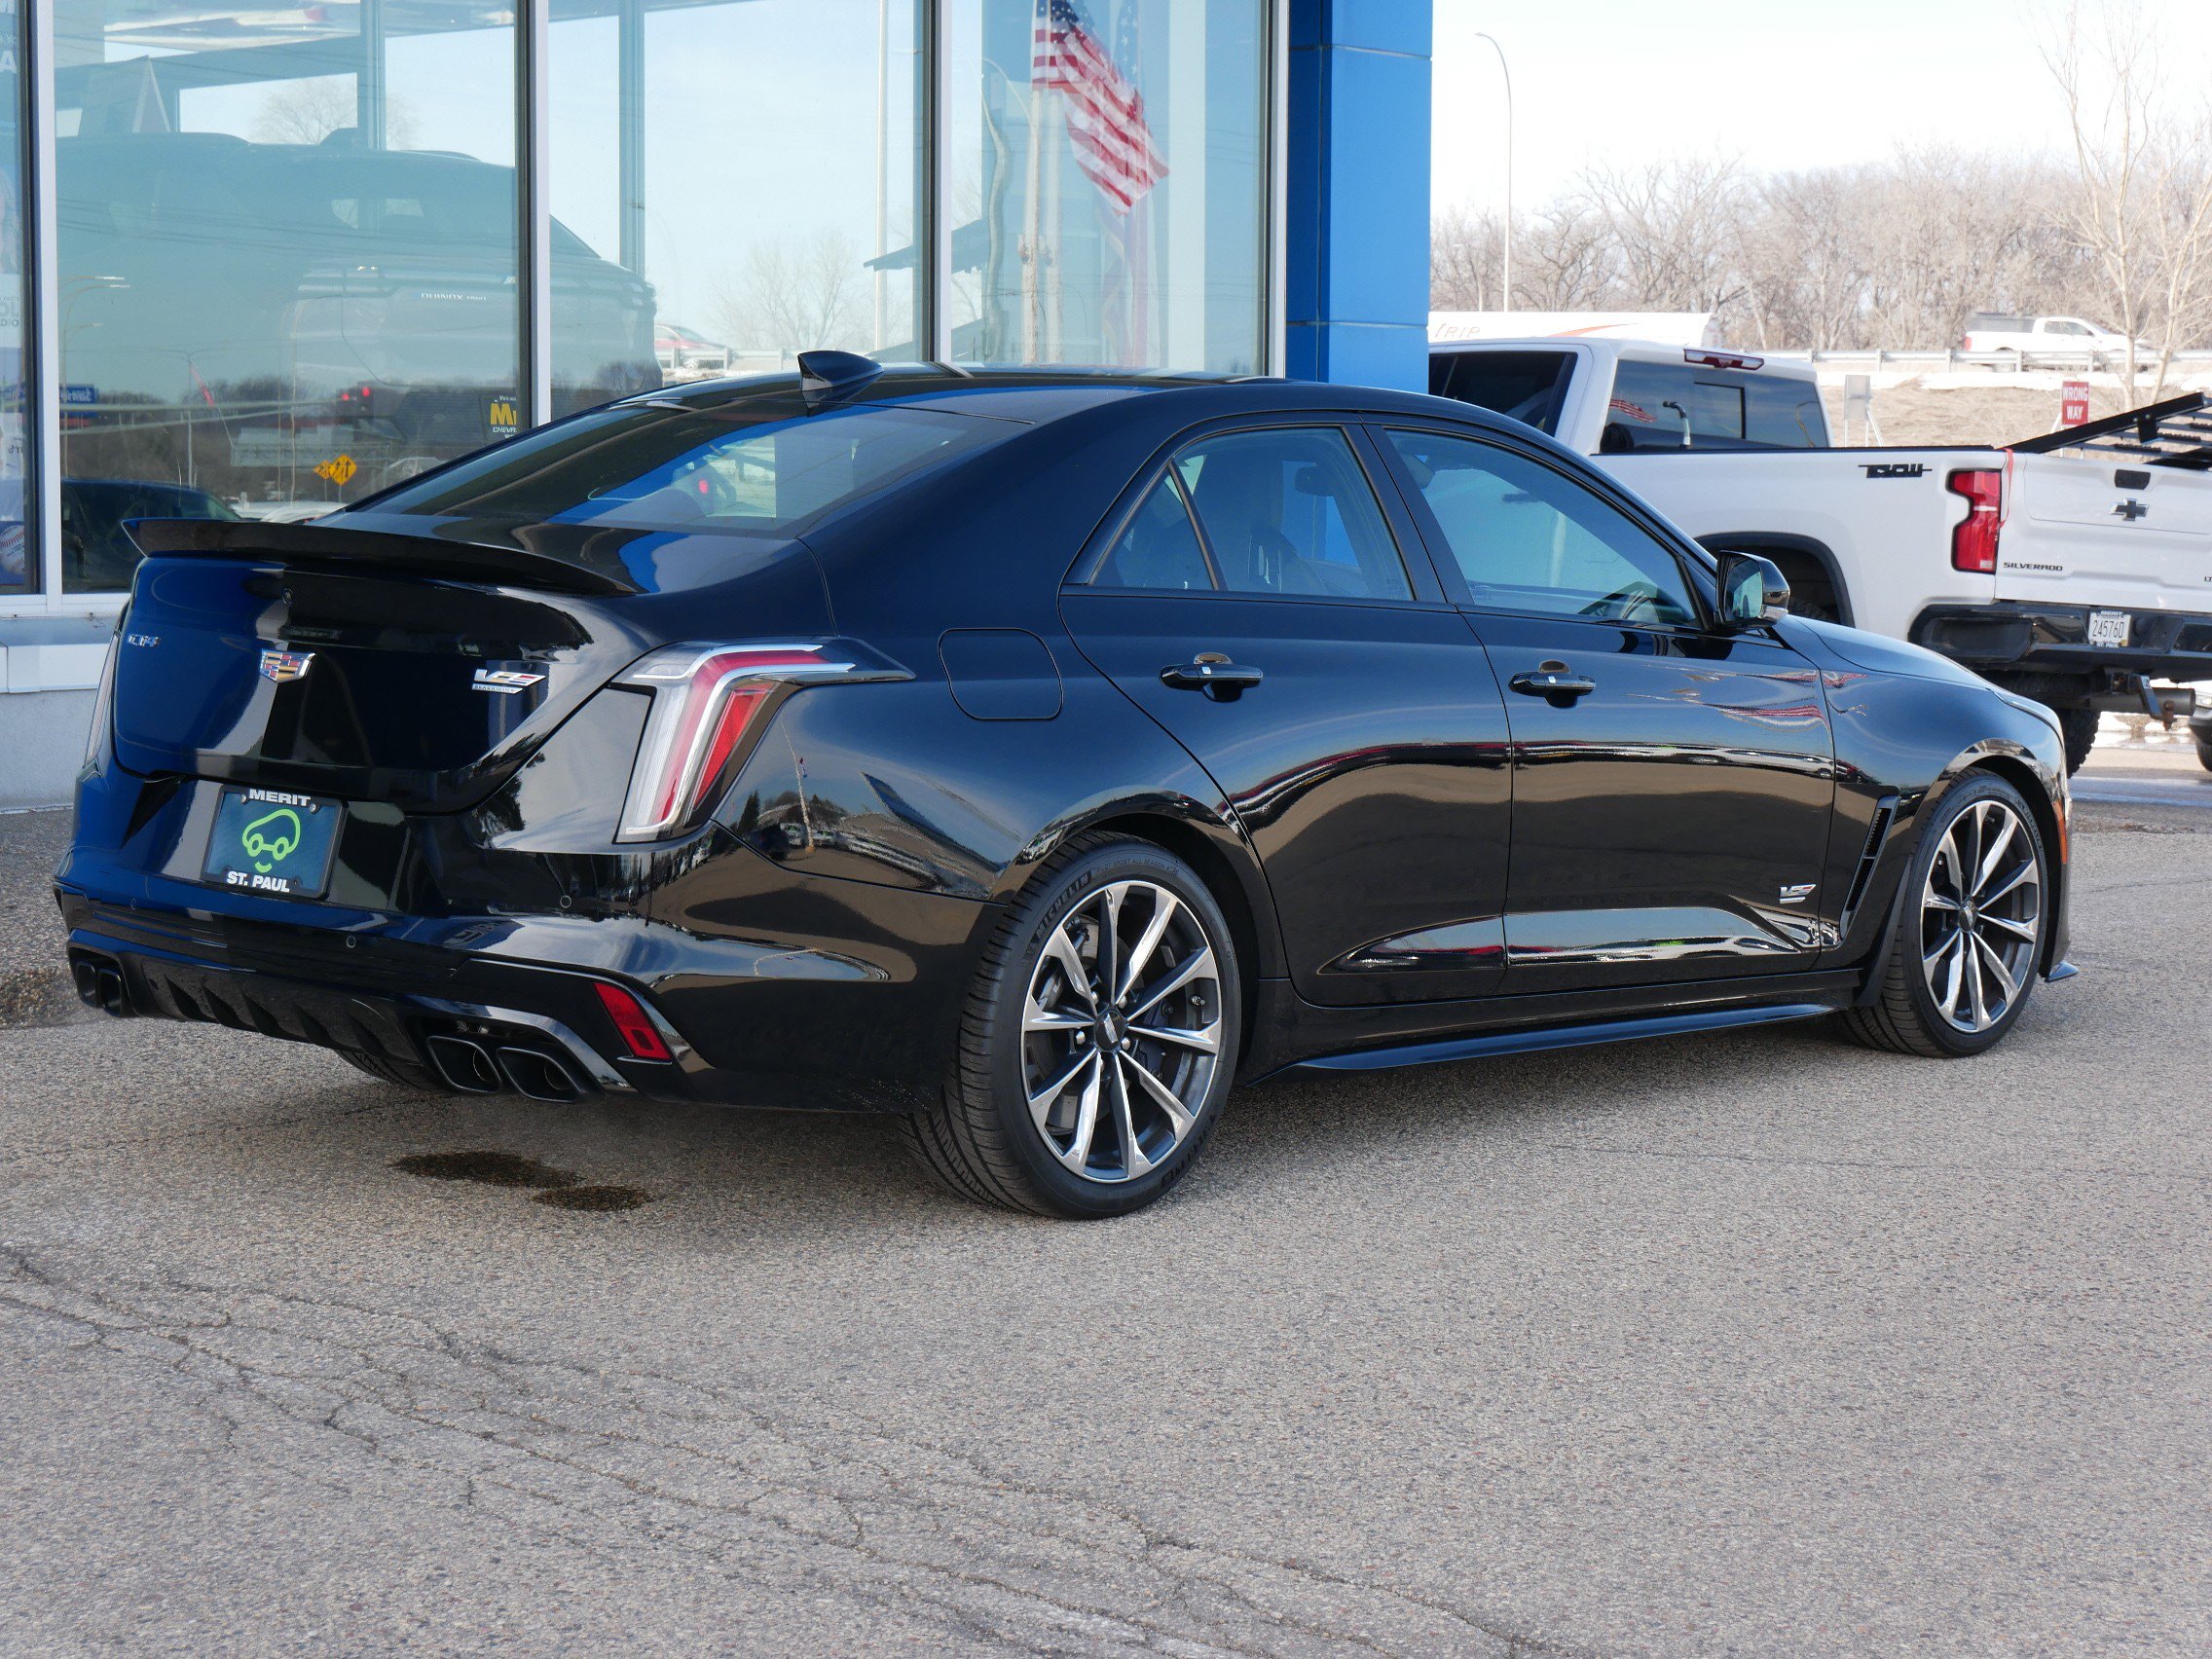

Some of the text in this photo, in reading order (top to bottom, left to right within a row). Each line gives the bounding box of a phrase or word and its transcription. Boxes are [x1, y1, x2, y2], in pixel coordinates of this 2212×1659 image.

[2062, 387, 2088, 401] WRONG
[2066, 405, 2083, 420] WAY
[2003, 562, 2064, 571] SILVERADO
[248, 788, 312, 807] MERIT
[226, 870, 291, 893] ST. PAUL
[1035, 872, 1091, 940] MICHELIN
